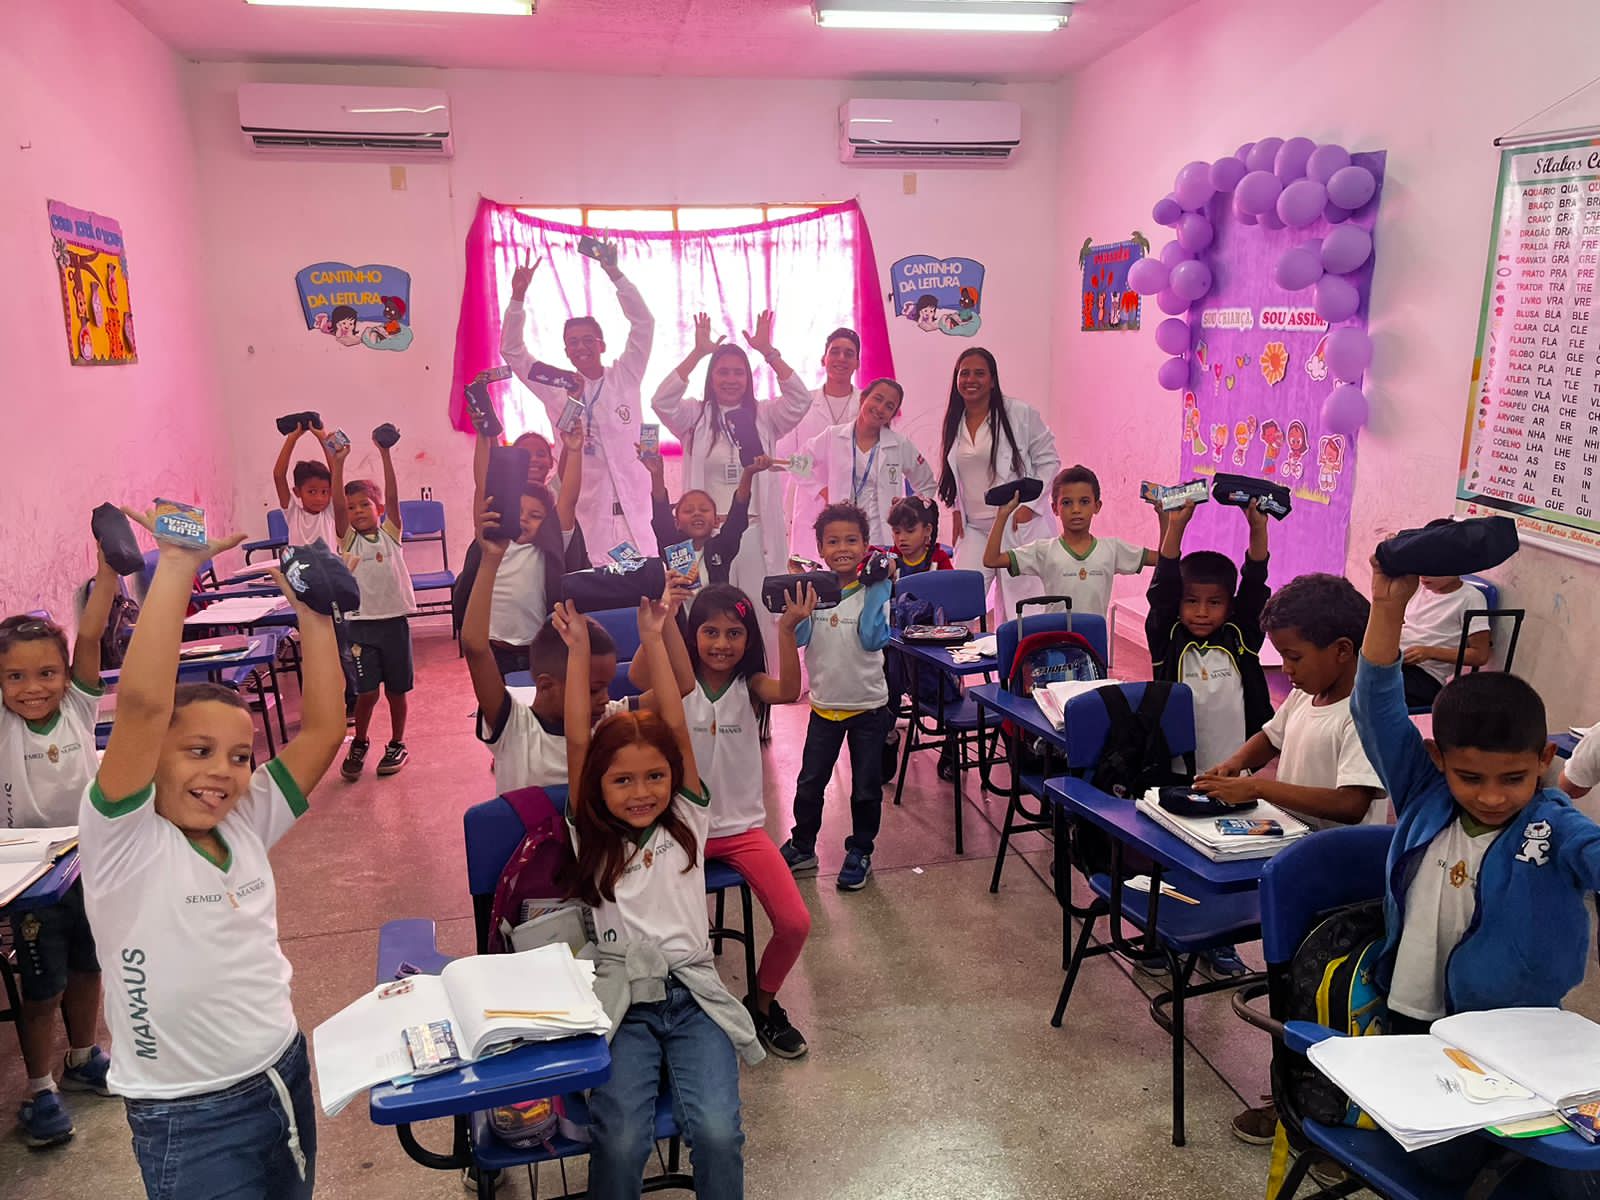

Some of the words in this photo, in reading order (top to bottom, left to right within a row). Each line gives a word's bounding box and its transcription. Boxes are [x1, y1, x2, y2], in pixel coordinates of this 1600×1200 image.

[1561, 185, 1578, 194] QUA
[1528, 201, 1554, 210] BRAÇO
[1559, 199, 1576, 208] BRA
[1528, 215, 1552, 224] CRAVO
[1557, 213, 1574, 222] CRA
[1520, 227, 1550, 238] DRAGÃO
[1555, 227, 1572, 236] DRA
[1520, 242, 1548, 250] FRALDA
[1554, 240, 1570, 250] FRA
[1582, 240, 1598, 250] FRE
[1516, 256, 1546, 264] GRAVATA
[1552, 254, 1570, 264] GRA
[1579, 254, 1597, 264] GRE
[904, 262, 962, 276] CANTINHO
[1522, 270, 1545, 278] PRATO
[1550, 268, 1568, 278] PRA
[1577, 269, 1596, 278] PRE
[310, 270, 383, 284] CANTINHO
[899, 280, 916, 292] DA
[918, 276, 960, 289] LEITURA
[1516, 283, 1543, 291] TRATOR
[1549, 282, 1566, 292] TRA
[1576, 282, 1592, 292] TRE
[307, 294, 329, 309] DA
[330, 291, 383, 305] LEITURA
[1520, 296, 1542, 304] LIVRO
[1546, 296, 1564, 305] VRA
[1574, 297, 1592, 306] VRE
[1203, 312, 1217, 324] SOU
[1262, 312, 1287, 325] SOU
[1516, 310, 1540, 318] BLUSA
[1545, 310, 1562, 319] BLA
[1572, 311, 1590, 320] BLE
[1514, 323, 1537, 332] CLARA
[1543, 323, 1560, 332] CLA
[1570, 325, 1588, 335] CLE
[1510, 336, 1536, 344] FLAUTA
[1542, 336, 1557, 346] FLA
[1569, 339, 1585, 348] FLE
[1509, 350, 1534, 358] GLOBO
[1540, 350, 1556, 360] GLA
[1566, 352, 1584, 362] GLE
[1509, 362, 1532, 371] PLACA
[1538, 364, 1554, 373] PLA
[1565, 366, 1582, 376] PLE
[1505, 376, 1530, 385] ATLETA
[1537, 377, 1552, 386] TLA
[1564, 380, 1580, 390] TLE
[1534, 390, 1551, 400] VLA
[1562, 394, 1578, 404] VLE
[1532, 404, 1550, 414] CHA
[1559, 408, 1577, 418] CHE
[1532, 418, 1545, 426] AR
[1560, 421, 1572, 431] ER
[1589, 426, 1598, 436] IR
[1493, 425, 1522, 436] GALINHA
[1528, 430, 1546, 440] NHA
[1555, 434, 1574, 445] NHE
[1584, 439, 1600, 450] NHI
[1493, 438, 1521, 450] COELHO
[1526, 443, 1544, 453] LHA
[1554, 448, 1571, 458] LHE
[1583, 453, 1598, 464] LHI
[1491, 450, 1518, 462] ESCADA
[1526, 456, 1539, 466] AS
[1554, 461, 1566, 471] ES
[1584, 467, 1593, 476] IS
[1498, 464, 1517, 474] ANJO
[1524, 468, 1537, 478] AN
[1553, 474, 1564, 484] EN
[1582, 480, 1591, 490] IN
[1489, 475, 1516, 487] ALFACE
[1522, 481, 1534, 492] AL
[1552, 488, 1562, 497] EL
[1581, 494, 1590, 504] IL
[1482, 486, 1514, 500] FOGUETE
[1517, 494, 1536, 504] GUA
[1544, 500, 1566, 511] GUE
[1576, 506, 1592, 518] GUI
[160, 516, 204, 532] SOCIAL
[168, 524, 200, 537] CLUB
[672, 548, 688, 560] CLUB
[670, 554, 692, 568] SOCIAL
[185, 894, 222, 904] SEMED
[122, 948, 158, 1060] MANAUS
